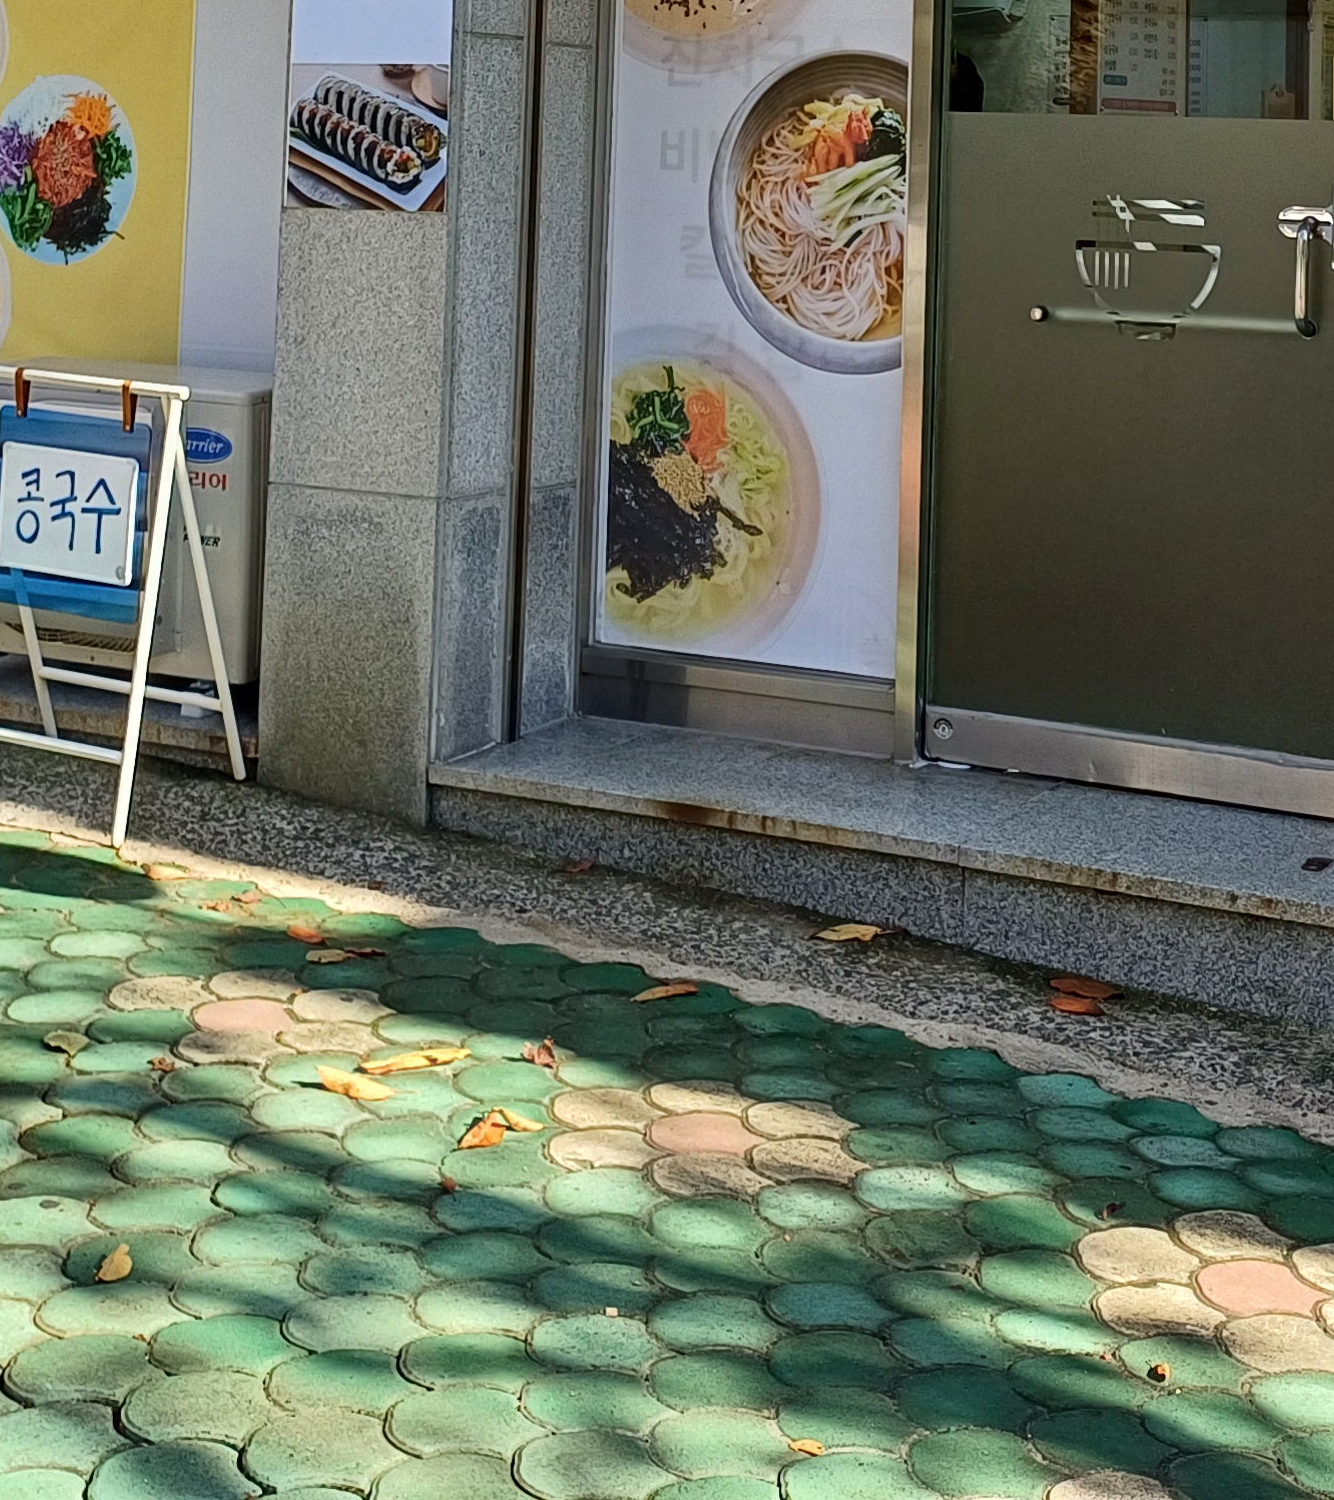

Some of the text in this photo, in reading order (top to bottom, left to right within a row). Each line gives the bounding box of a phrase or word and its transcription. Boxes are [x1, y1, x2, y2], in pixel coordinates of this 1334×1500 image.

[186, 438, 224, 455] arrier
[188, 470, 227, 491] 리어
[15, 467, 123, 555] 콩국수
